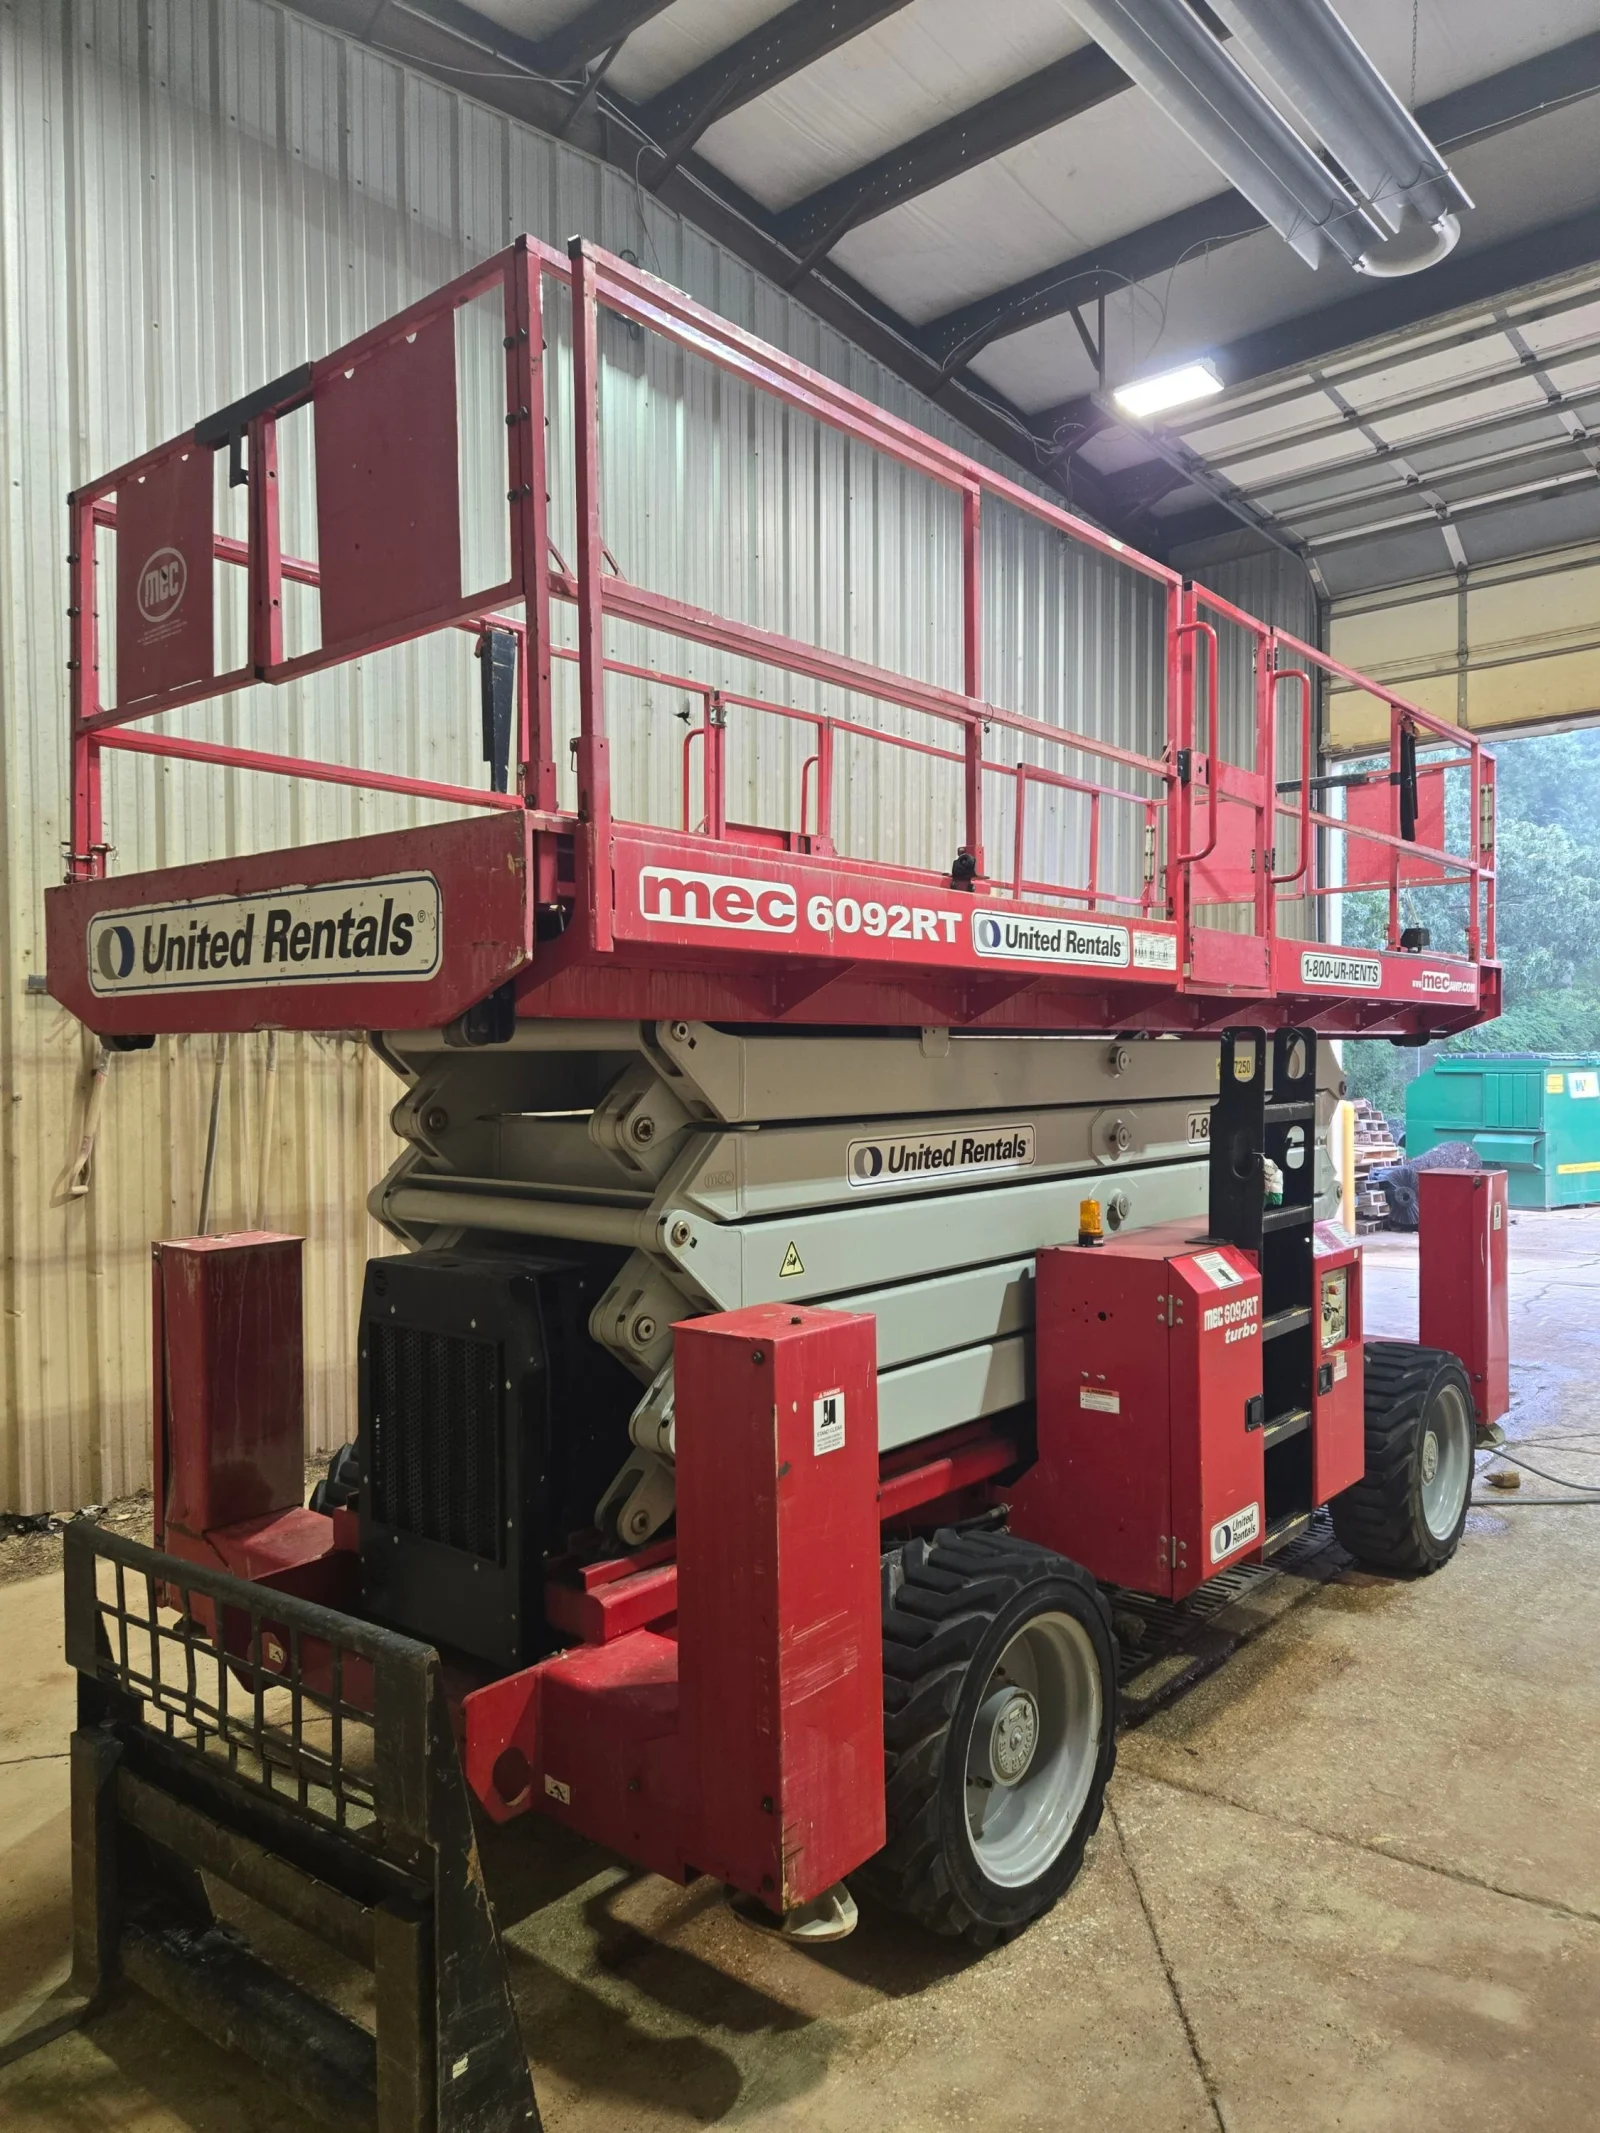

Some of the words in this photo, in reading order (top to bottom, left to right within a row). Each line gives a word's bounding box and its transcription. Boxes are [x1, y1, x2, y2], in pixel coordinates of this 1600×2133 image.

[643, 875, 796, 927] mec
[807, 896, 963, 943] 6092RT
[142, 913, 255, 974] United
[1005, 924, 1061, 953] United
[1065, 930, 1121, 957] Rentals
[1304, 959, 1379, 983] 1-800-UR-RENTS
[888, 1140, 957, 1173] United
[961, 1133, 1027, 1164] Rentals
[1224, 1295, 1259, 1325] 6092RT
[1225, 1322, 1257, 1344] turbo
[1232, 1510, 1254, 1531] United
[1233, 1523, 1256, 1545] Rentals
